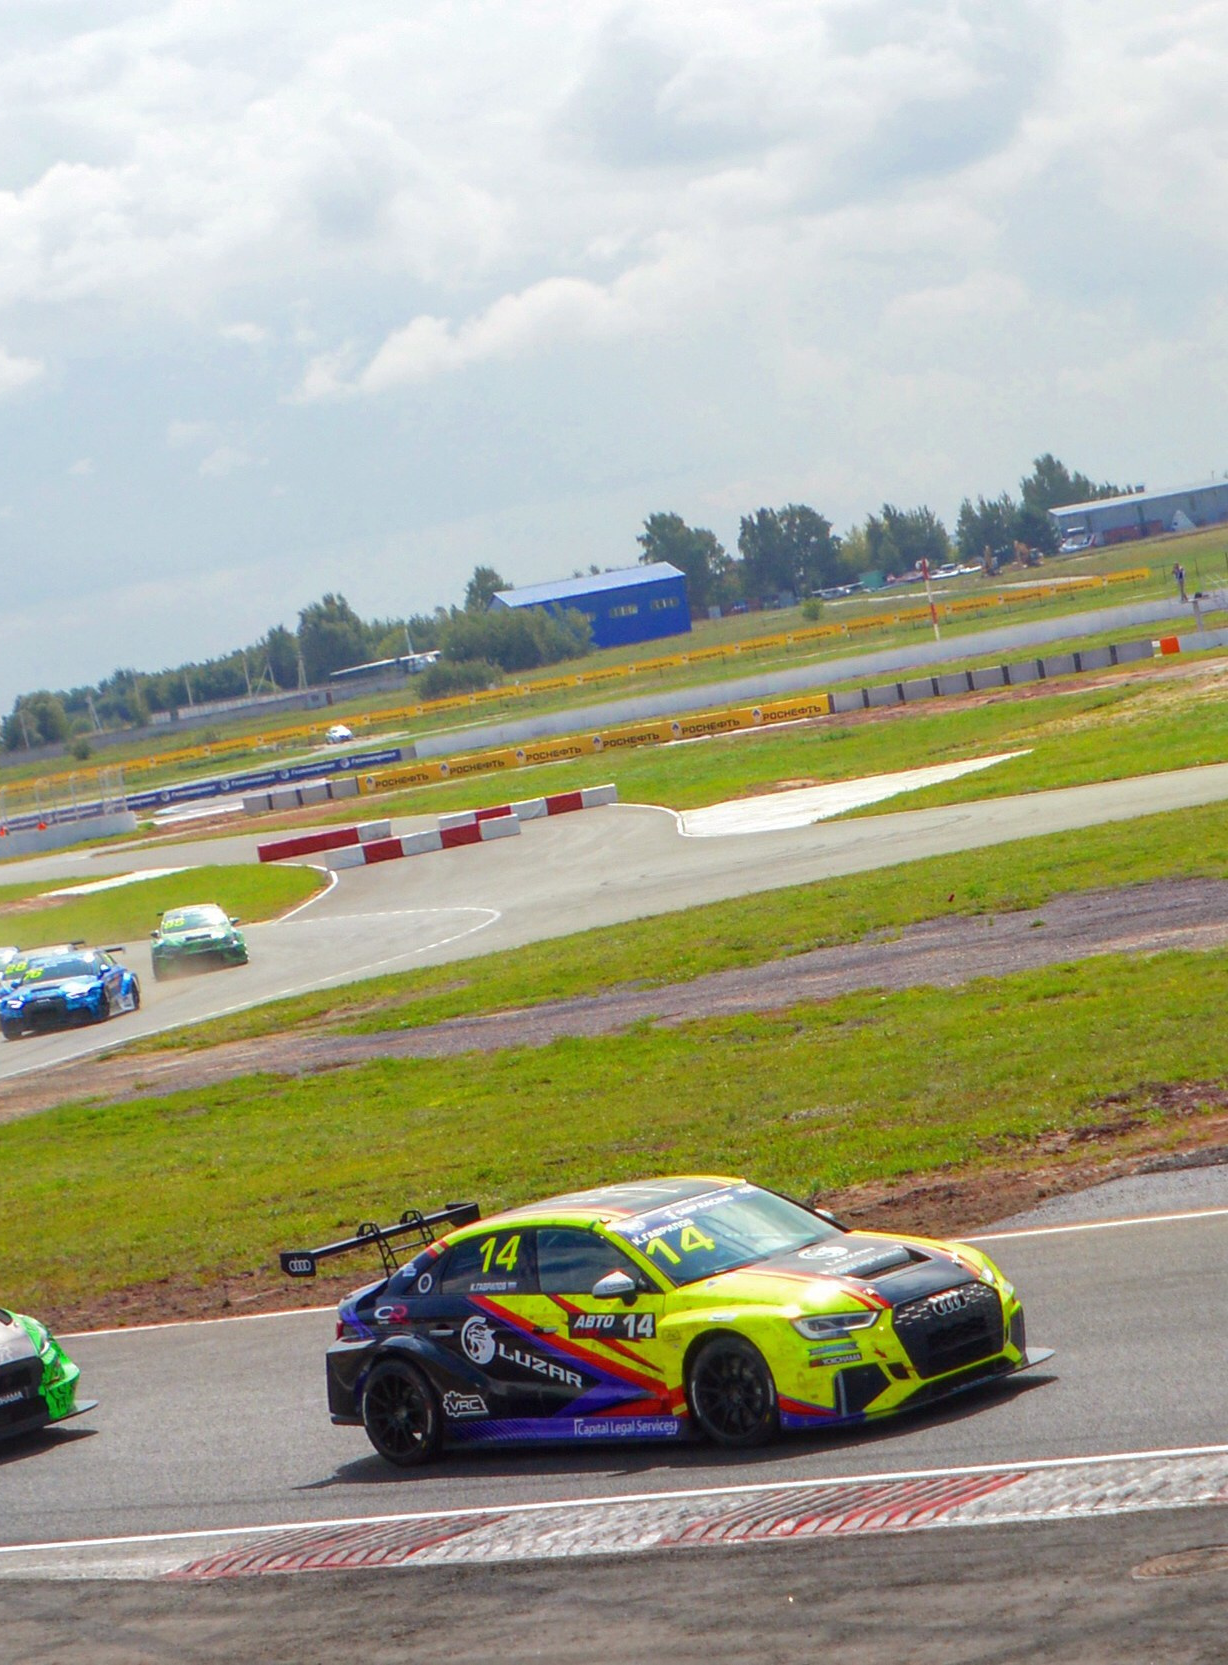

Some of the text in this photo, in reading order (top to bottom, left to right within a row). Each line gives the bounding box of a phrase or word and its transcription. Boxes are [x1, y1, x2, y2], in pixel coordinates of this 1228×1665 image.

[763, 705, 821, 721] РОСНЕФТЬ
[682, 718, 740, 735] РОСНЕФТЬ
[602, 732, 660, 748] РОСНЕФТЬ
[526, 746, 582, 762] РОСНЕФТЬ
[449, 759, 505, 775] РОСНЕФТЬ
[375, 773, 429, 789] РОСНЕФТЬ
[645, 1225, 716, 1265] 14
[479, 1235, 521, 1274] 14
[573, 1314, 616, 1329] АВТО
[622, 1314, 654, 1338] 14
[498, 1342, 583, 1389] LUZAR
[449, 1400, 481, 1412] VRC
[577, 1418, 673, 1437] Capital Legal Services
